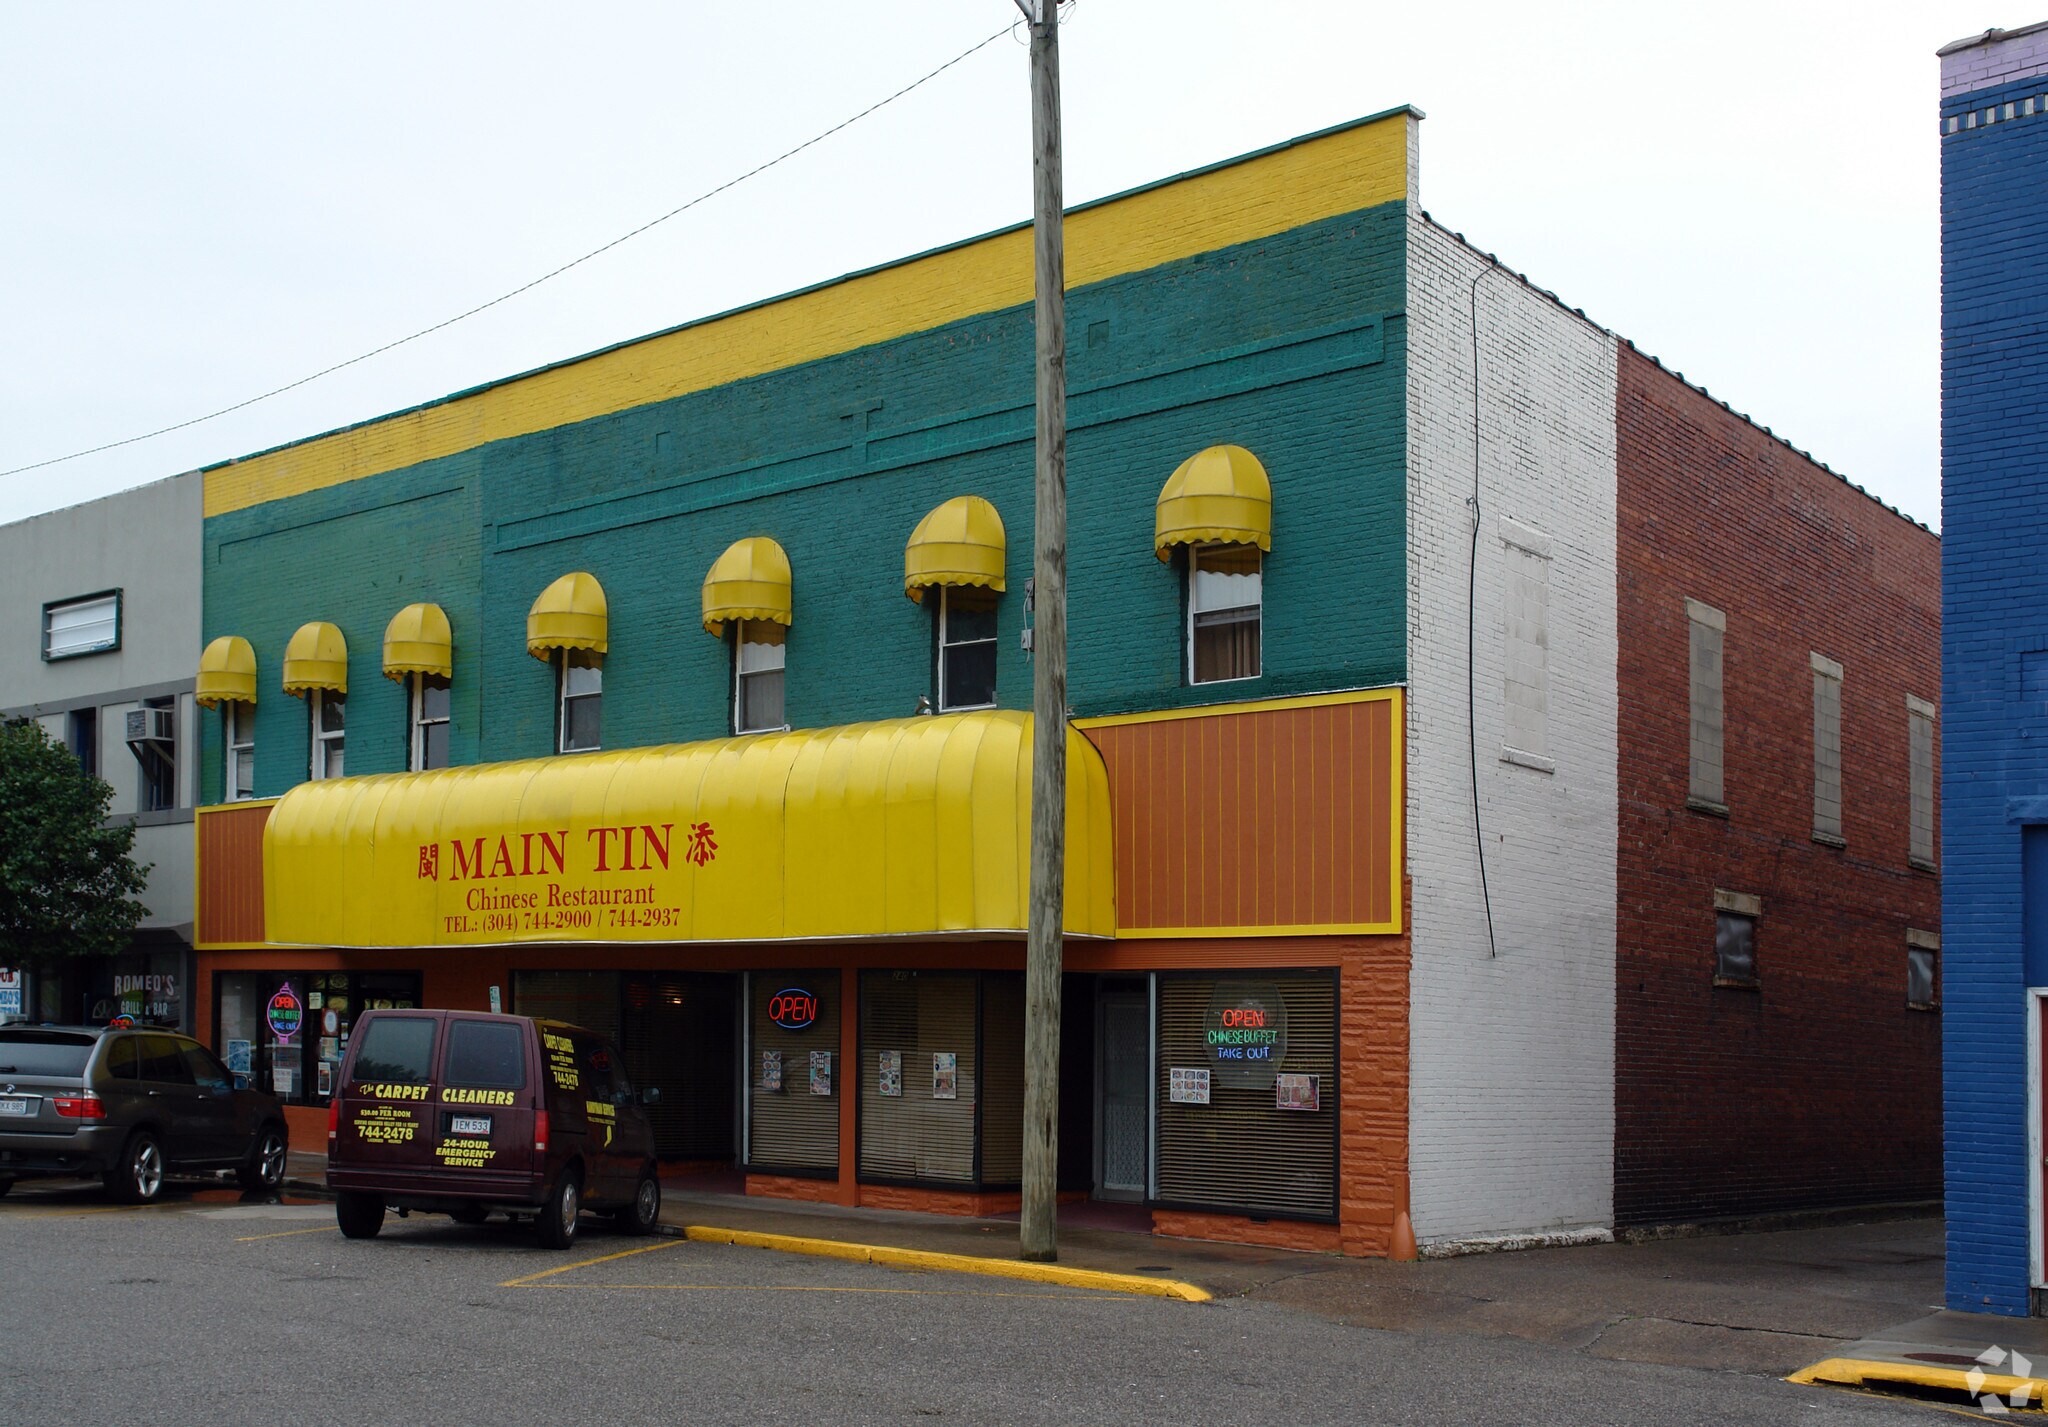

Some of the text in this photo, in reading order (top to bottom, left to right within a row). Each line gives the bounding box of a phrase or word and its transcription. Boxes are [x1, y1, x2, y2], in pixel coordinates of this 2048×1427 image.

[685, 822, 719, 867] 添
[449, 824, 674, 881] MAIN TIN
[466, 883, 655, 911] Chinese Restaurant
[483, 913, 518, 935] (304)
[524, 910, 591, 931] 744-2900
[609, 908, 681, 928] 744-2937
[114, 974, 175, 996] ROMEO'S
[121, 1000, 140, 1015] GRILL
[153, 1002, 168, 1016] BAR
[274, 996, 295, 1009] OPEN
[769, 997, 817, 1021] OPEN
[1222, 1009, 1265, 1027] OPEN
[1208, 1030, 1278, 1045] CHINESE BUFFET
[1218, 1046, 1270, 1059] TAKE OUT
[375, 1084, 429, 1100] CARPET
[442, 1088, 514, 1105] CLEANERS
[379, 1109, 392, 1118] PER
[393, 1110, 411, 1119] ROOM
[358, 1126, 414, 1140] 744-2478
[472, 1121, 488, 1131] 533
[443, 1138, 489, 1150] 24-HOUR
[436, 1148, 496, 1159] EMERGENCY
[444, 1157, 484, 1168] SERVICE
